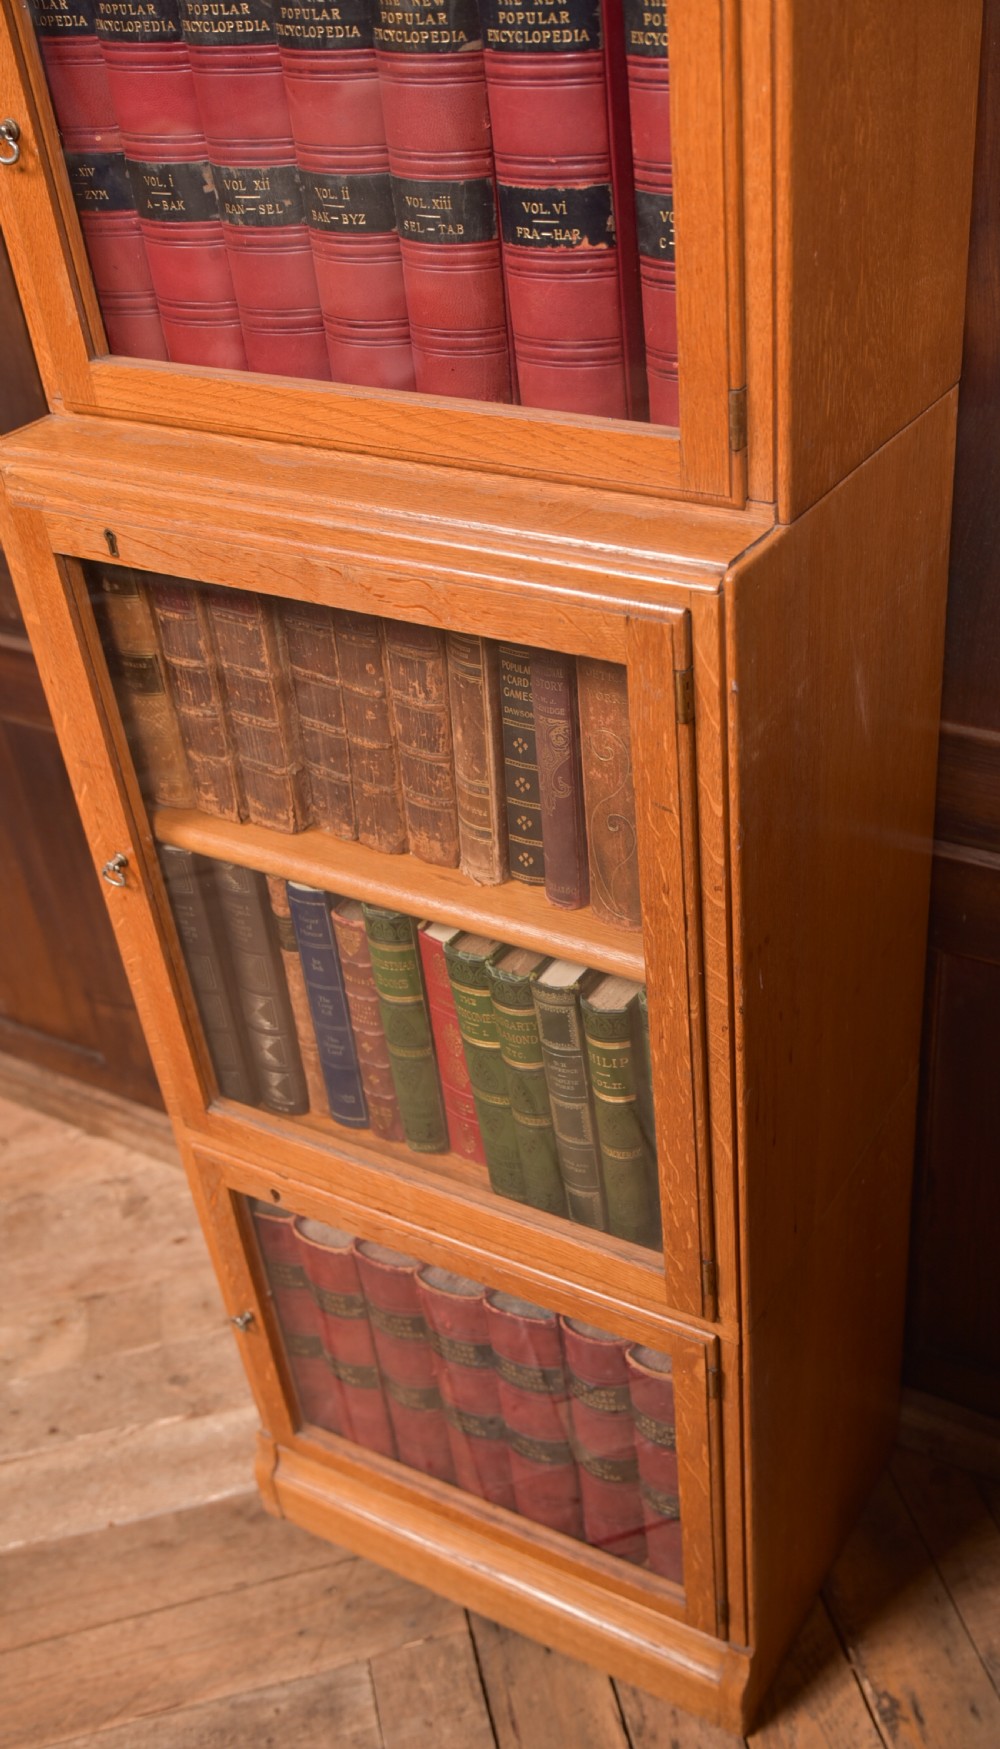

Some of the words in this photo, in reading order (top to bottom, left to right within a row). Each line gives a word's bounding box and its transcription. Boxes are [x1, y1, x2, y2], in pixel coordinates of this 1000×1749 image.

[100, 3, 156, 16] POPULAR
[187, 3, 250, 16] POPULAR
[281, 7, 341, 21] POPULAR
[35, 15, 89, 28] LOPEDIA
[380, 11, 449, 26] POPULAR
[497, 11, 571, 25] POPULAR
[95, 18, 177, 33] ENCYCLOPEDIA
[182, 20, 271, 33] ENCYCLOPEDIA
[276, 23, 362, 38] ENCYCLOPEDIA
[373, 27, 468, 44] ENCYCLOPEDIA
[487, 29, 591, 44] ENCYCLOPEDIA
[522, 201, 551, 215] VOL.
[507, 675, 529, 688] CARD
[503, 687, 533, 702] GAMES
[504, 705, 534, 719] DAWSON
